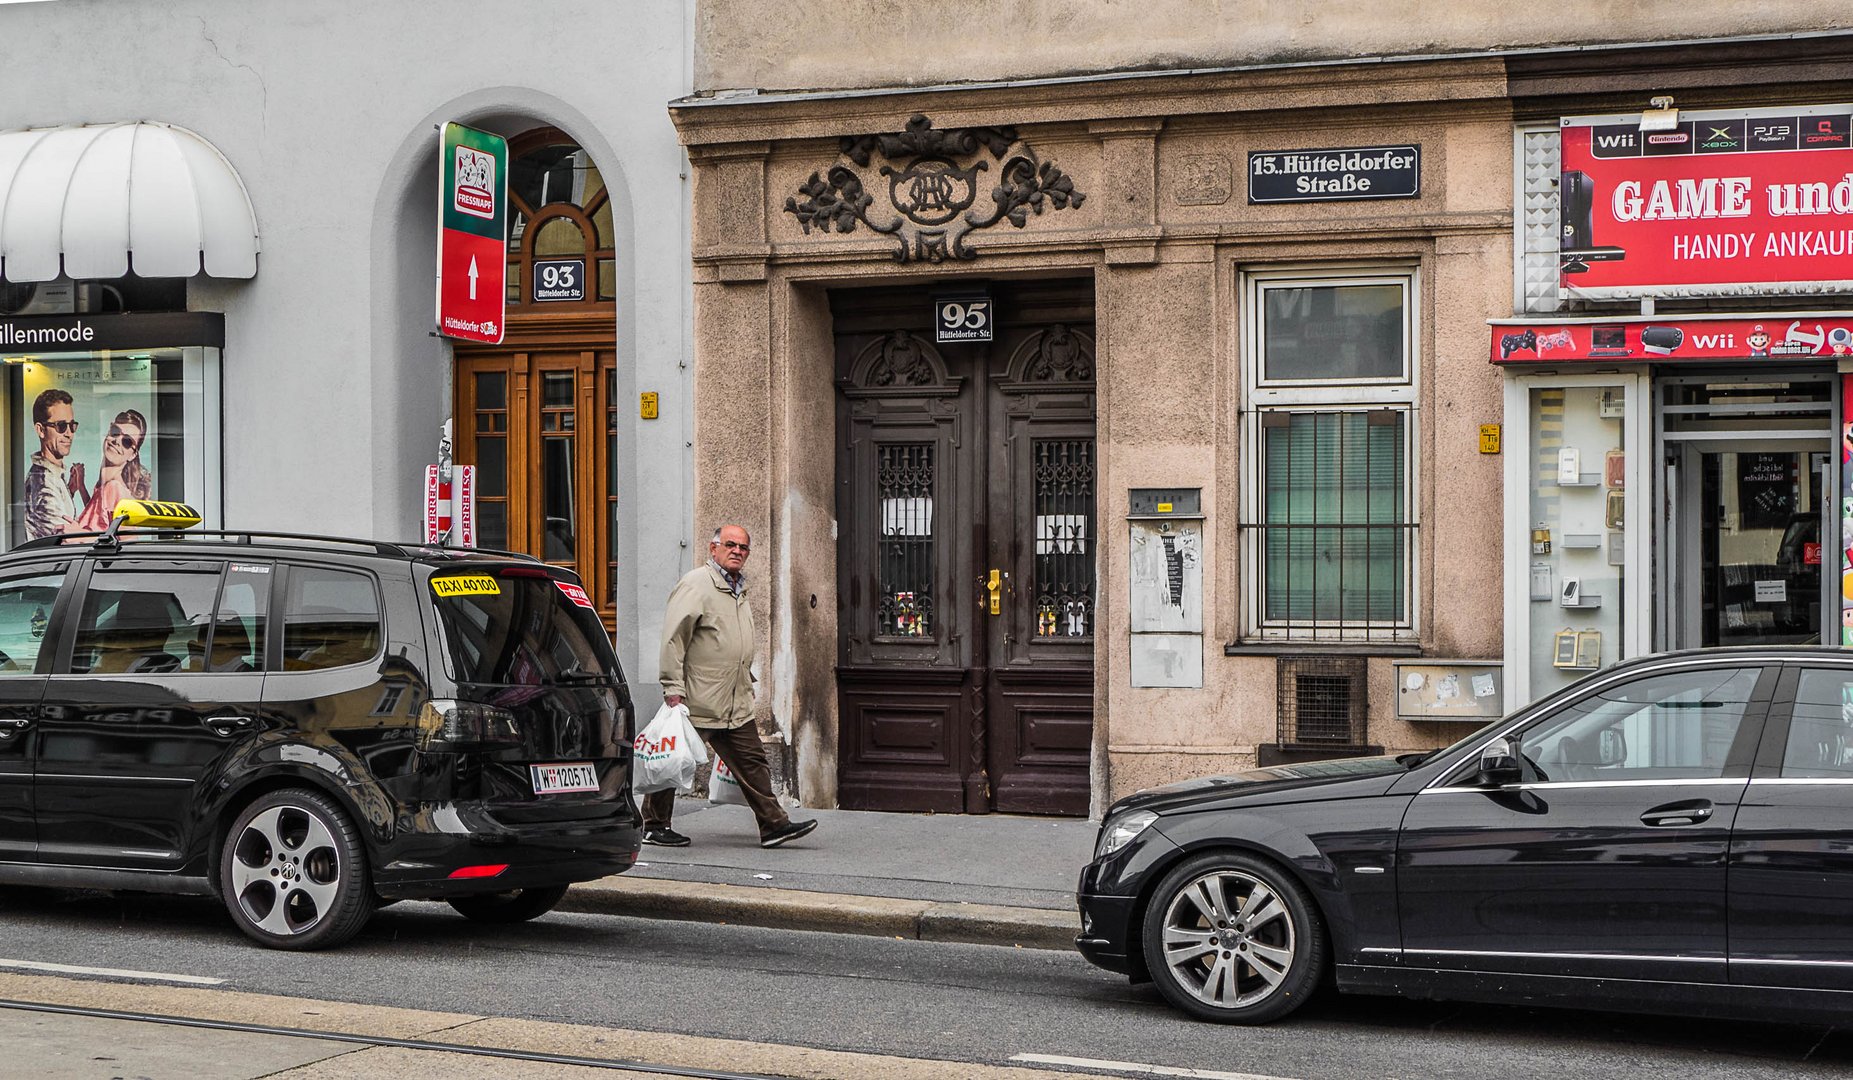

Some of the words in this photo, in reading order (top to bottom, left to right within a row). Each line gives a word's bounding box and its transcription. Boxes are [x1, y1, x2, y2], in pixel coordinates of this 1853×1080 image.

[1650, 135, 1686, 143] Nintendo
[1754, 126, 1790, 136] PS3
[1598, 134, 1634, 148] Wii
[1284, 152, 1414, 174] Hütteldorfer
[1296, 174, 1371, 193] Straße
[458, 193, 492, 210] FRESSNAPF
[1612, 176, 1752, 222] GAME
[1766, 172, 1853, 217] und
[1674, 232, 1756, 260] HANDY
[542, 266, 574, 288] 93
[538, 290, 570, 298] Hütteldorfer
[942, 302, 988, 328] 95
[446, 316, 480, 332] Hütteldorfer
[1692, 334, 1734, 348] Wii
[58, 371, 117, 380] HERITAGE
[142, 502, 194, 517] TAXI
[434, 581, 463, 594] TAXI
[463, 578, 497, 592] 40100
[557, 767, 581, 788] 1205
[582, 766, 595, 786] TX
